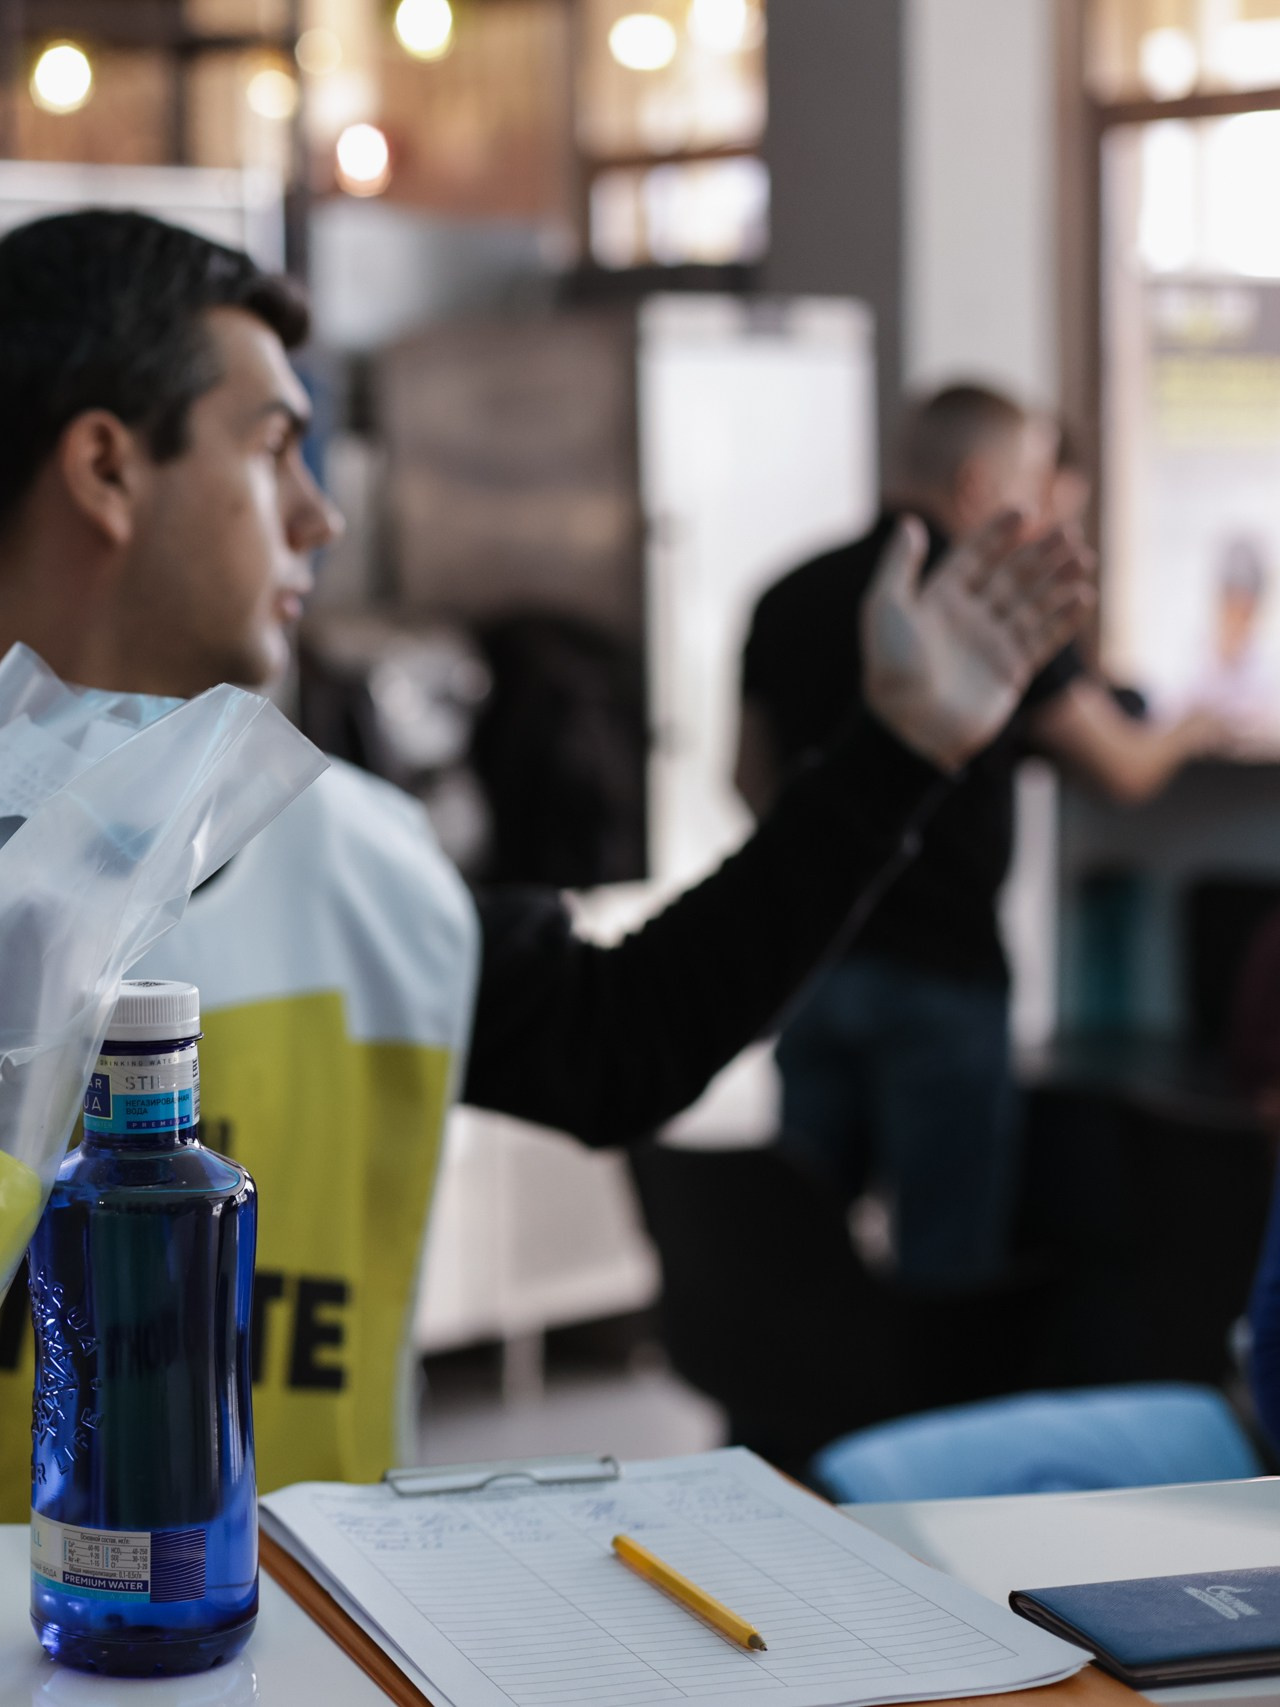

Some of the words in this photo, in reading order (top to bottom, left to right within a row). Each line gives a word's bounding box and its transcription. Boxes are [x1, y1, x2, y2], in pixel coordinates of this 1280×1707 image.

[125, 1094, 190, 1108] НЕГАЗИРОВАНАЯ
[126, 1107, 149, 1116] ВОДА
[132, 1116, 188, 1128] PREMIUM
[64, 1574, 106, 1588] PREMIUM
[108, 1580, 143, 1590] WATER
